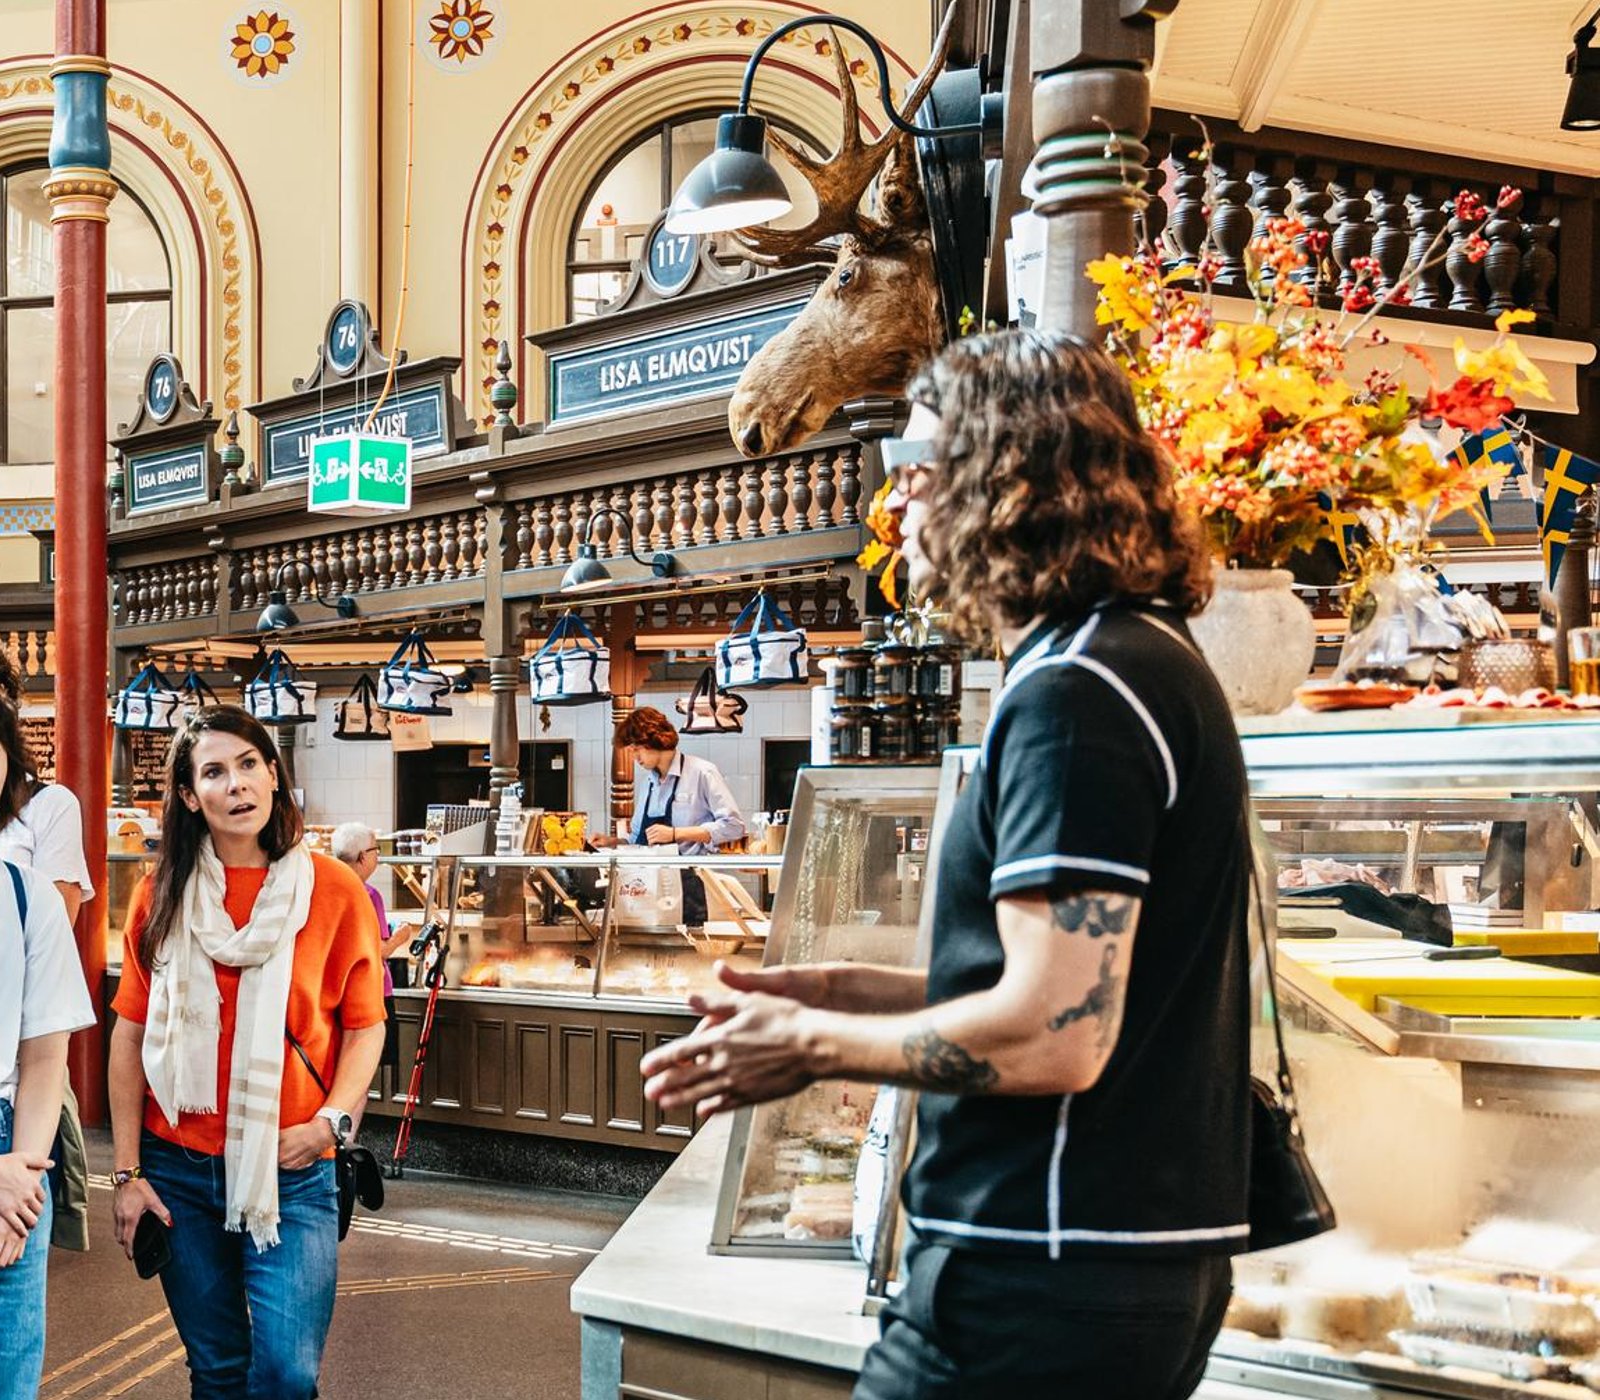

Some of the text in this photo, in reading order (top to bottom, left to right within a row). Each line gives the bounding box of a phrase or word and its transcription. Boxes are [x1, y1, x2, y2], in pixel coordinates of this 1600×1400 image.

[656, 235, 690, 268] 117
[338, 323, 356, 350] 76
[600, 334, 753, 392] LISA ELMQVIST
[155, 376, 171, 400] 76
[138, 463, 200, 489] LISA ELMQVIST
